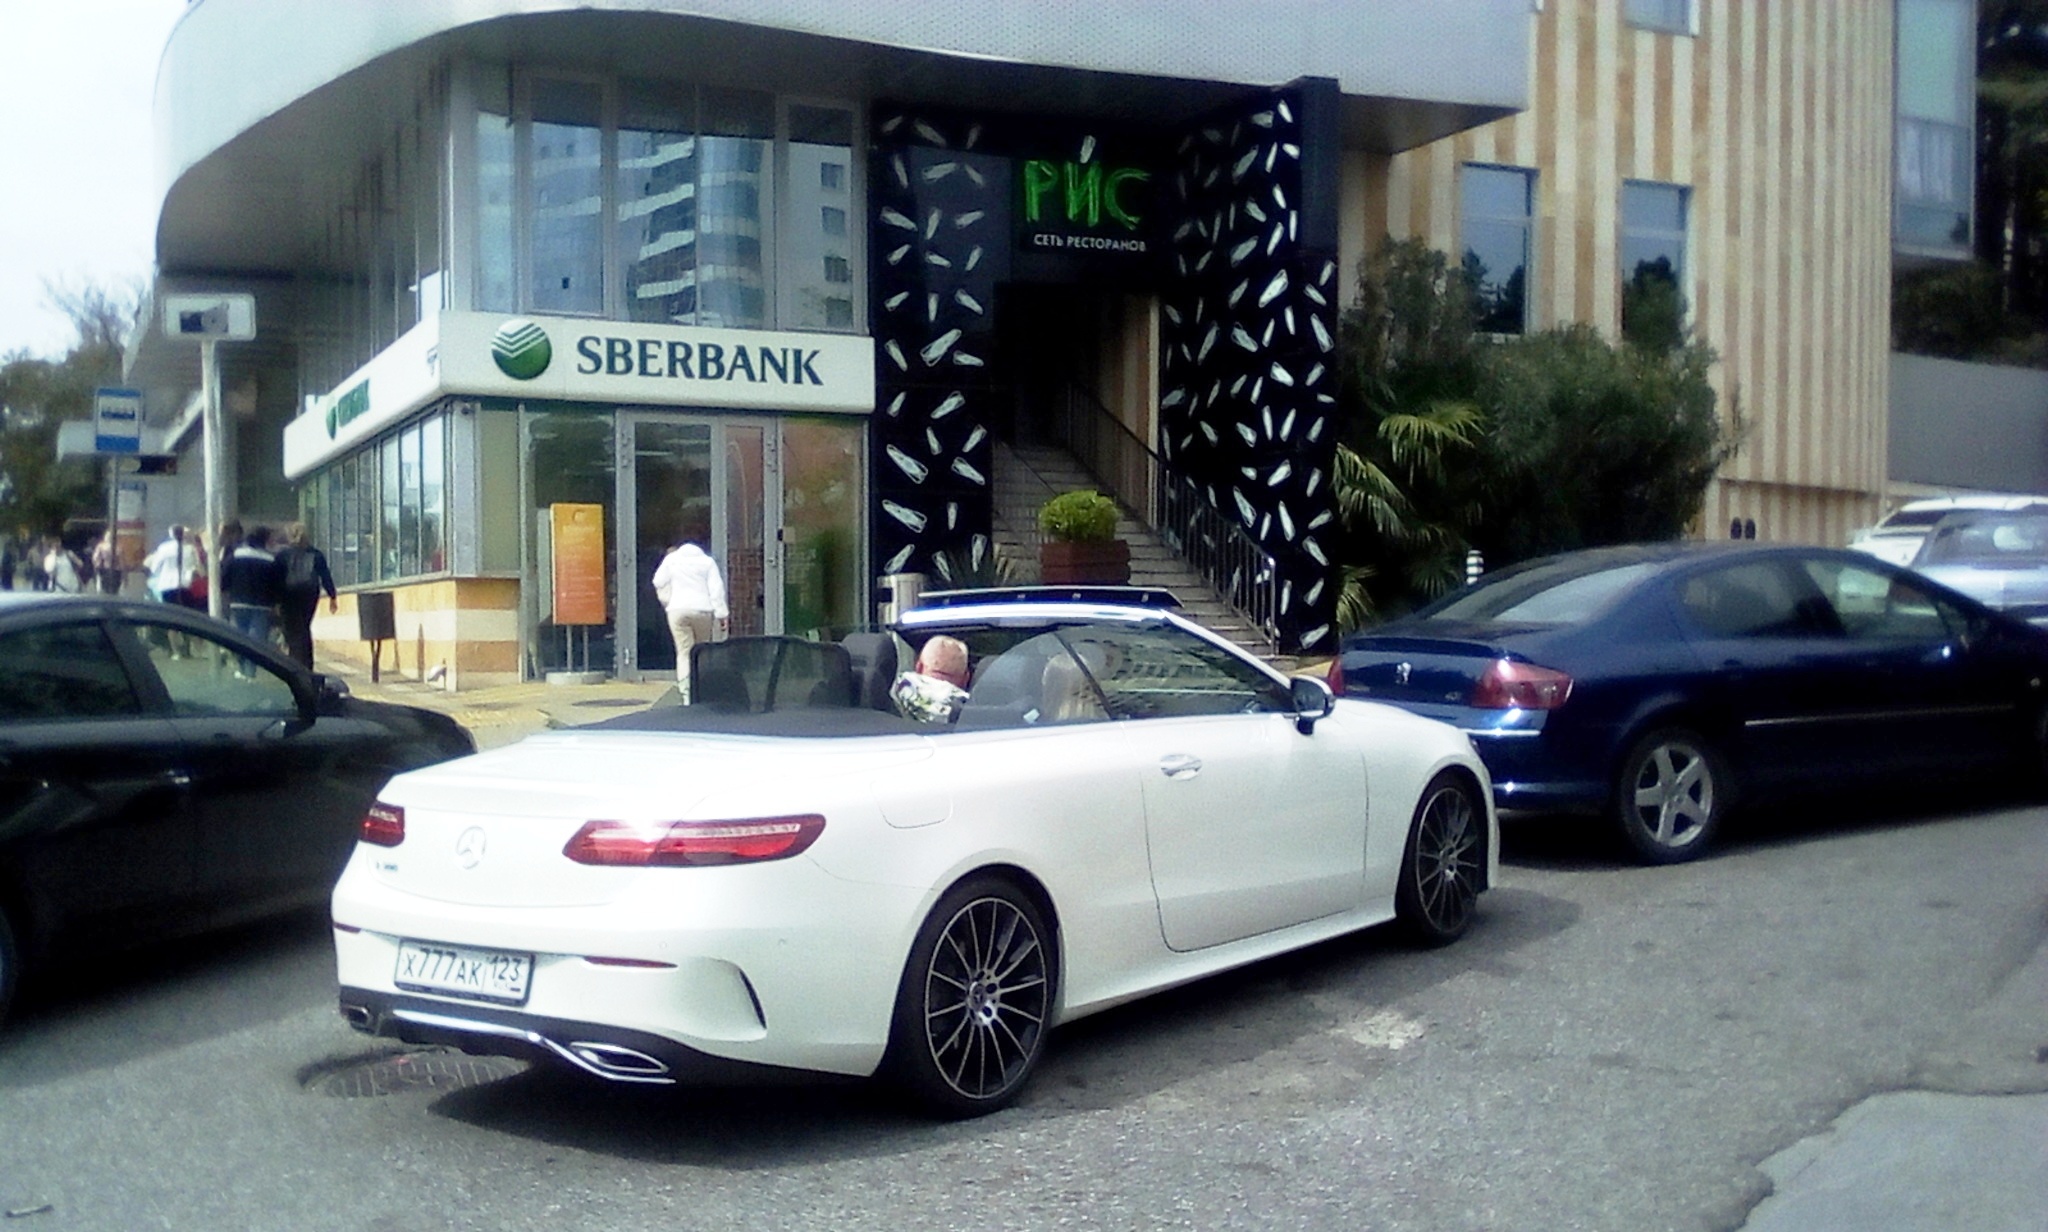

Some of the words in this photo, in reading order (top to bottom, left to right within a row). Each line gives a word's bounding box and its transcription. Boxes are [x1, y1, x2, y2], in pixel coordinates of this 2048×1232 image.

[1033, 233, 1064, 248] СЕТЬ
[1066, 235, 1147, 253] РЕСТОРАНОВ
[576, 335, 824, 386] SBERBANK
